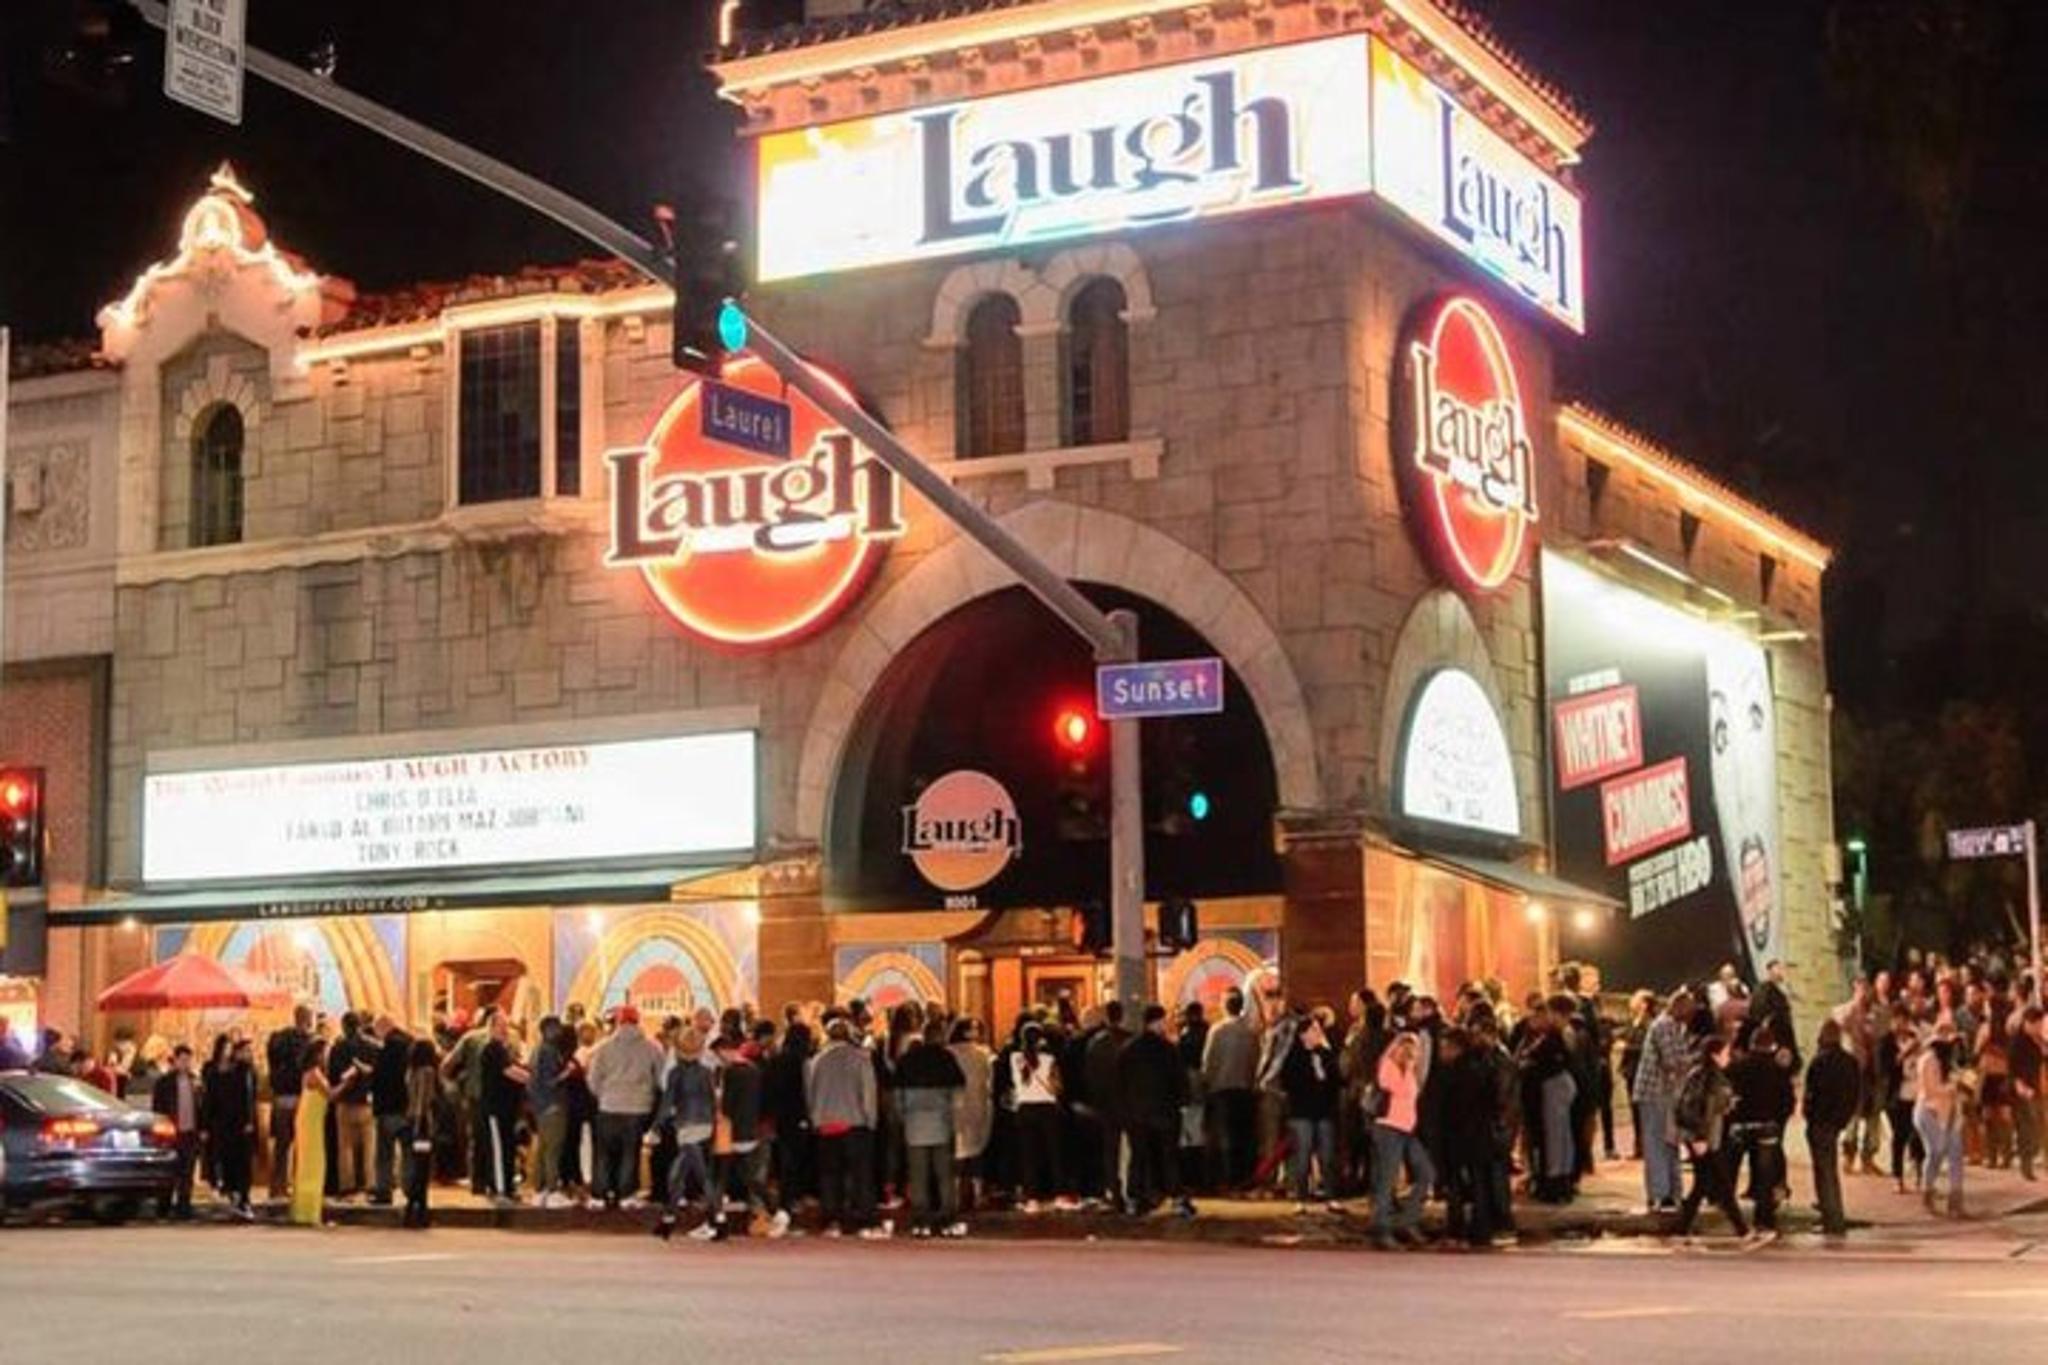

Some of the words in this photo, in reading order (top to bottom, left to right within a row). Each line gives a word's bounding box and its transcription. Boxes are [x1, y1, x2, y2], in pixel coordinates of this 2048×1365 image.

[913, 69, 1302, 245] Laugh
[1441, 99, 1569, 309] Laugh
[710, 393, 783, 441] Laurel
[1413, 343, 1536, 519] Laugh
[605, 431, 904, 561] Laugh
[1113, 674, 1208, 704] Sunset
[383, 756, 469, 781] LAUGH
[478, 749, 589, 775] FACTORY
[1560, 698, 1635, 777] WHITNEY
[903, 805, 1022, 856] Laugh
